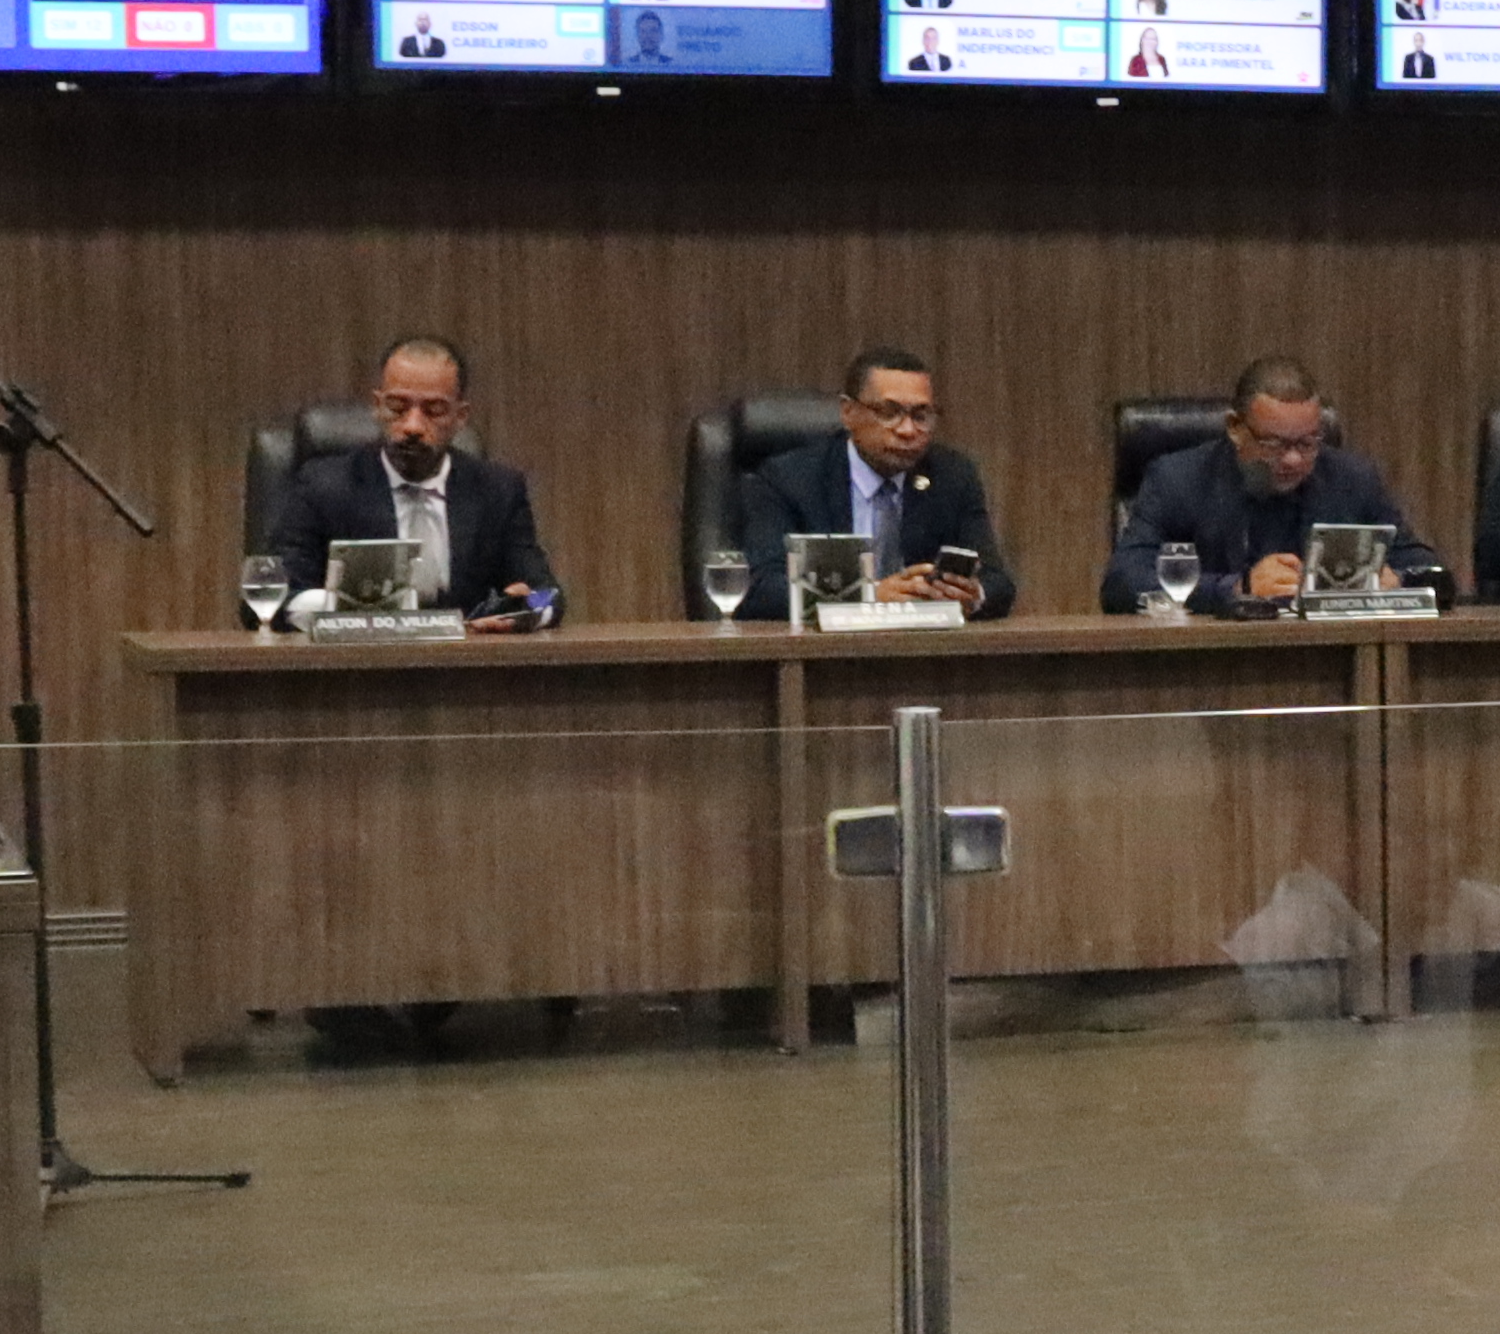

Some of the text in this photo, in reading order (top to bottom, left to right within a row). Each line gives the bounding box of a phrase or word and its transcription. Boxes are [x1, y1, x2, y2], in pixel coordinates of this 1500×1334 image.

[452, 21, 499, 33] EDSON
[958, 27, 1036, 39] MARLUS DO
[452, 37, 548, 50] CABELEIREIRO
[1176, 41, 1262, 54] PROFESSORA
[1444, 52, 1490, 63] WILTON
[958, 60, 967, 69] A
[1177, 57, 1275, 71] IARA PIMENTEL
[317, 615, 458, 629] AILTON DO VILLAGE
